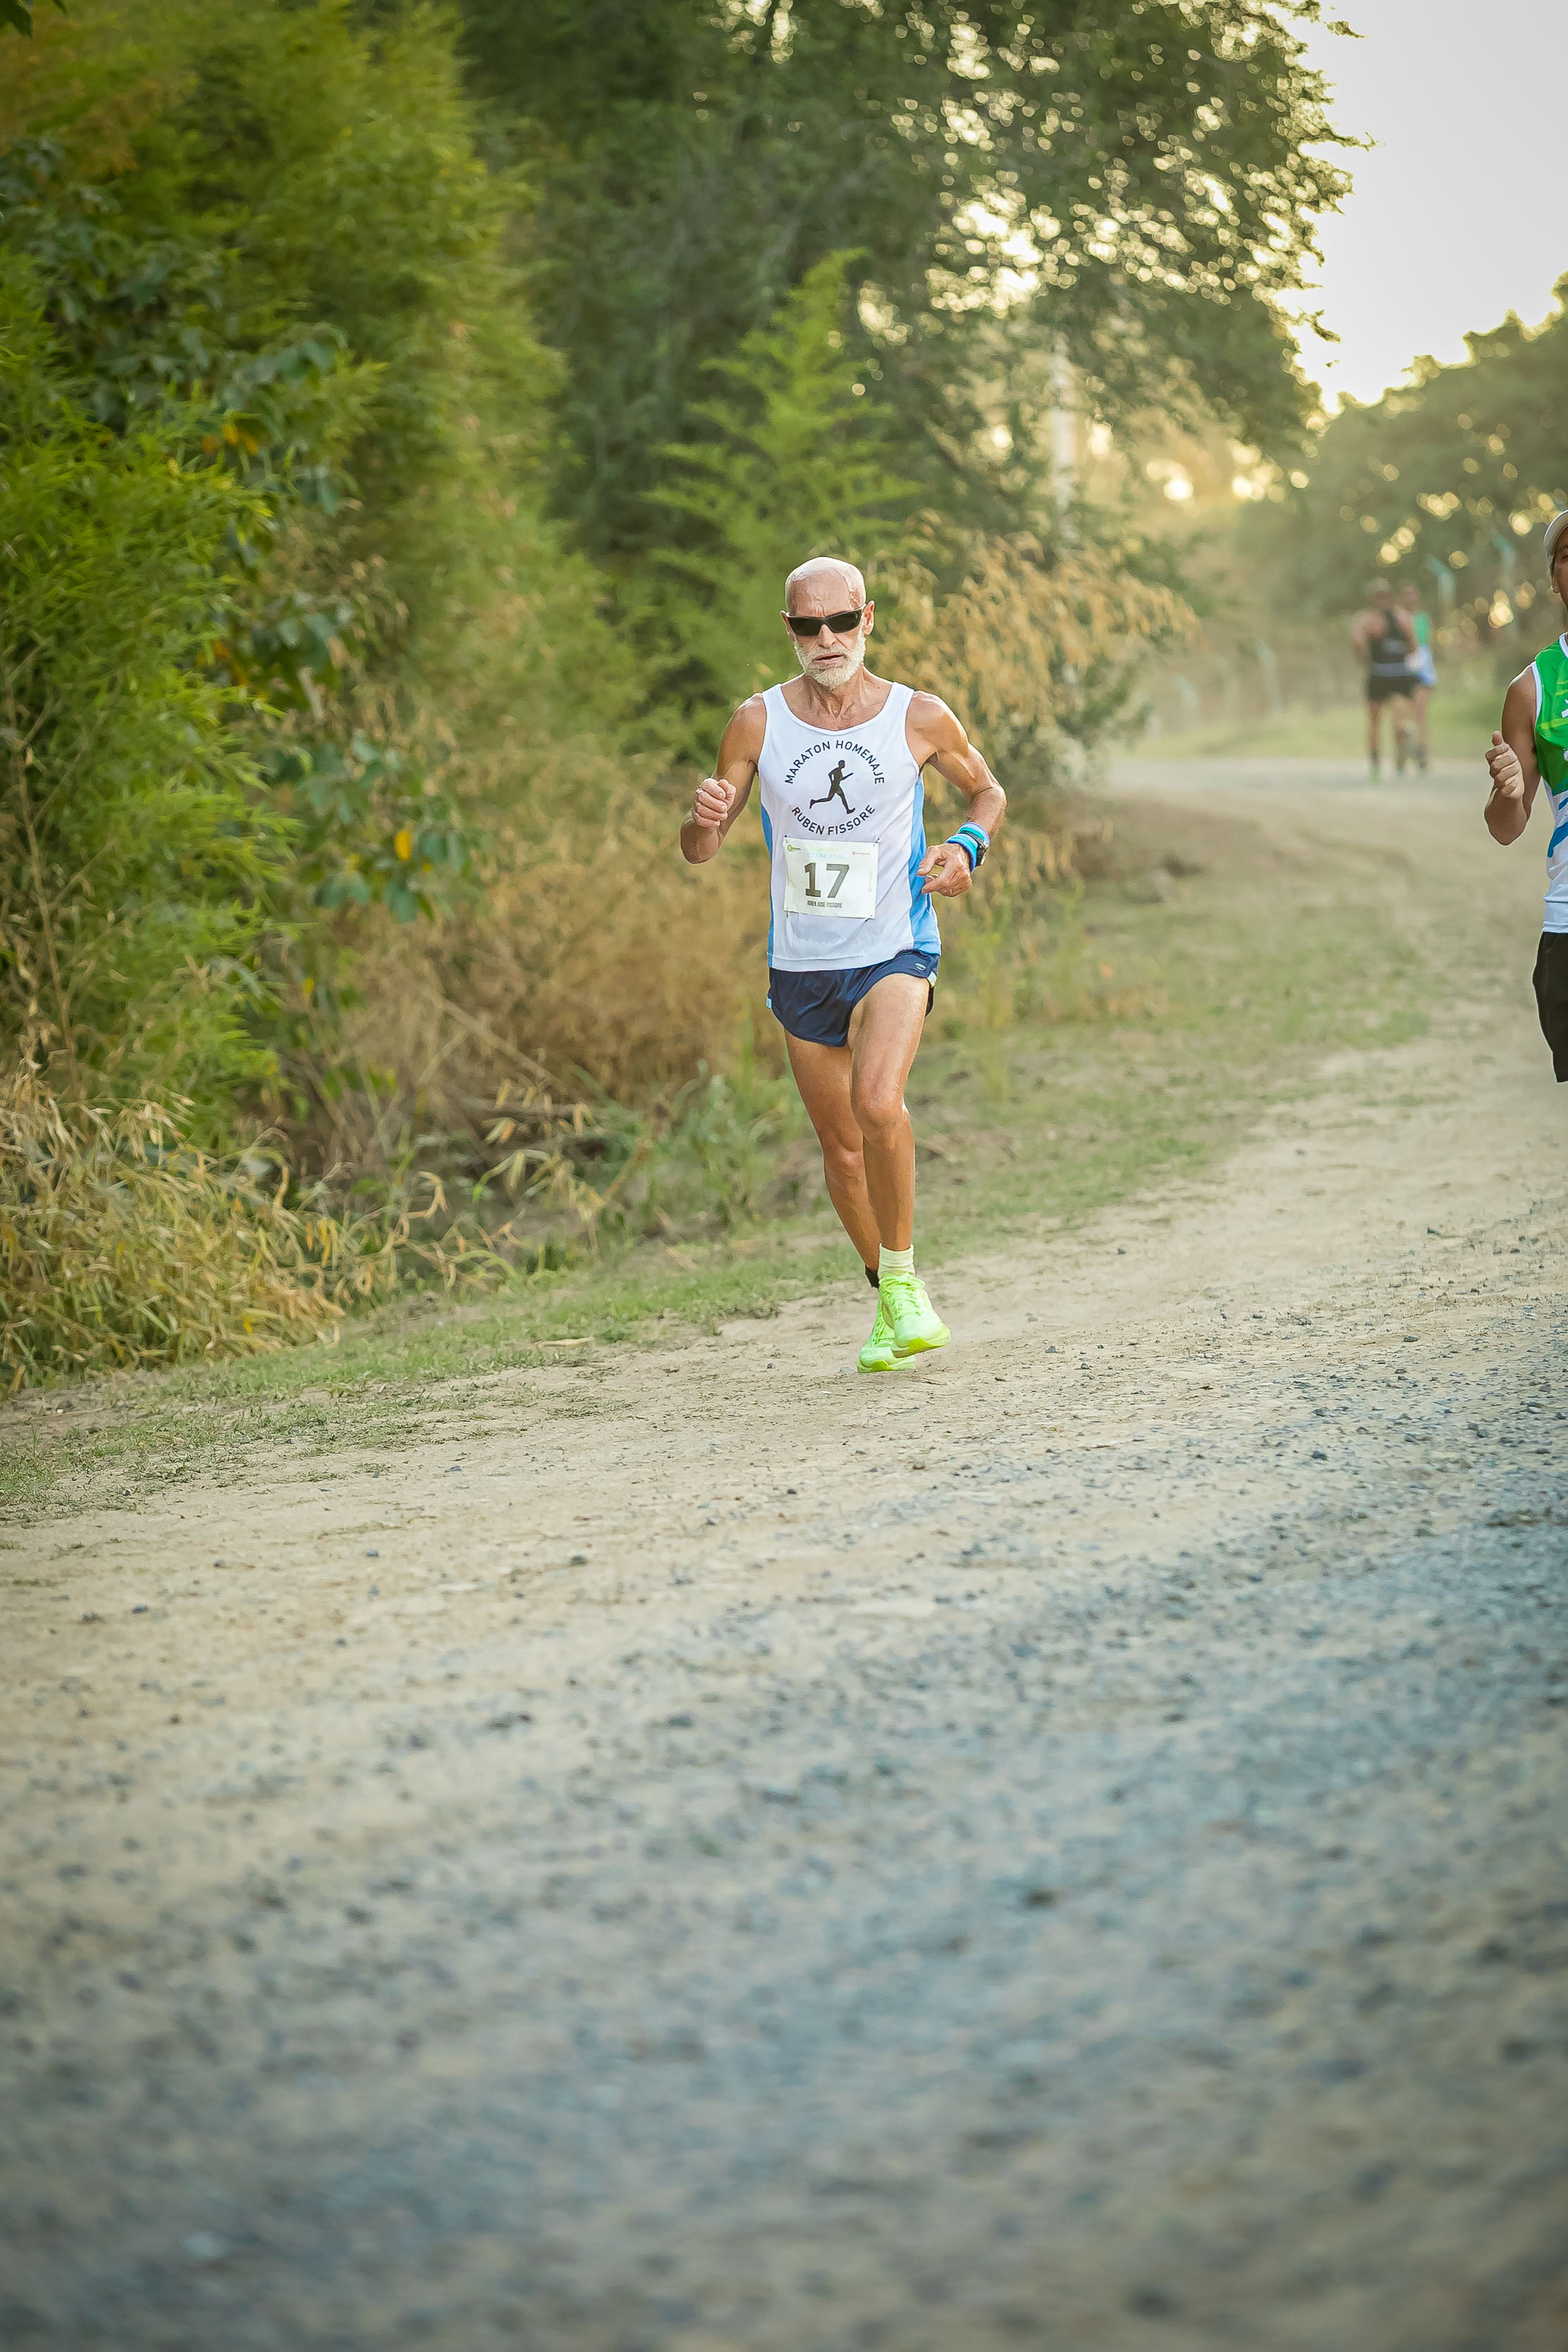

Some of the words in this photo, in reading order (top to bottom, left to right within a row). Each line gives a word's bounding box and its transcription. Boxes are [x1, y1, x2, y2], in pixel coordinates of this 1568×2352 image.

[784, 741, 830, 784] MARATON
[836, 740, 884, 784] HOMENAJE
[791, 806, 824, 835] RUBEN
[827, 804, 875, 836] FISSORE
[804, 862, 850, 899] 17
